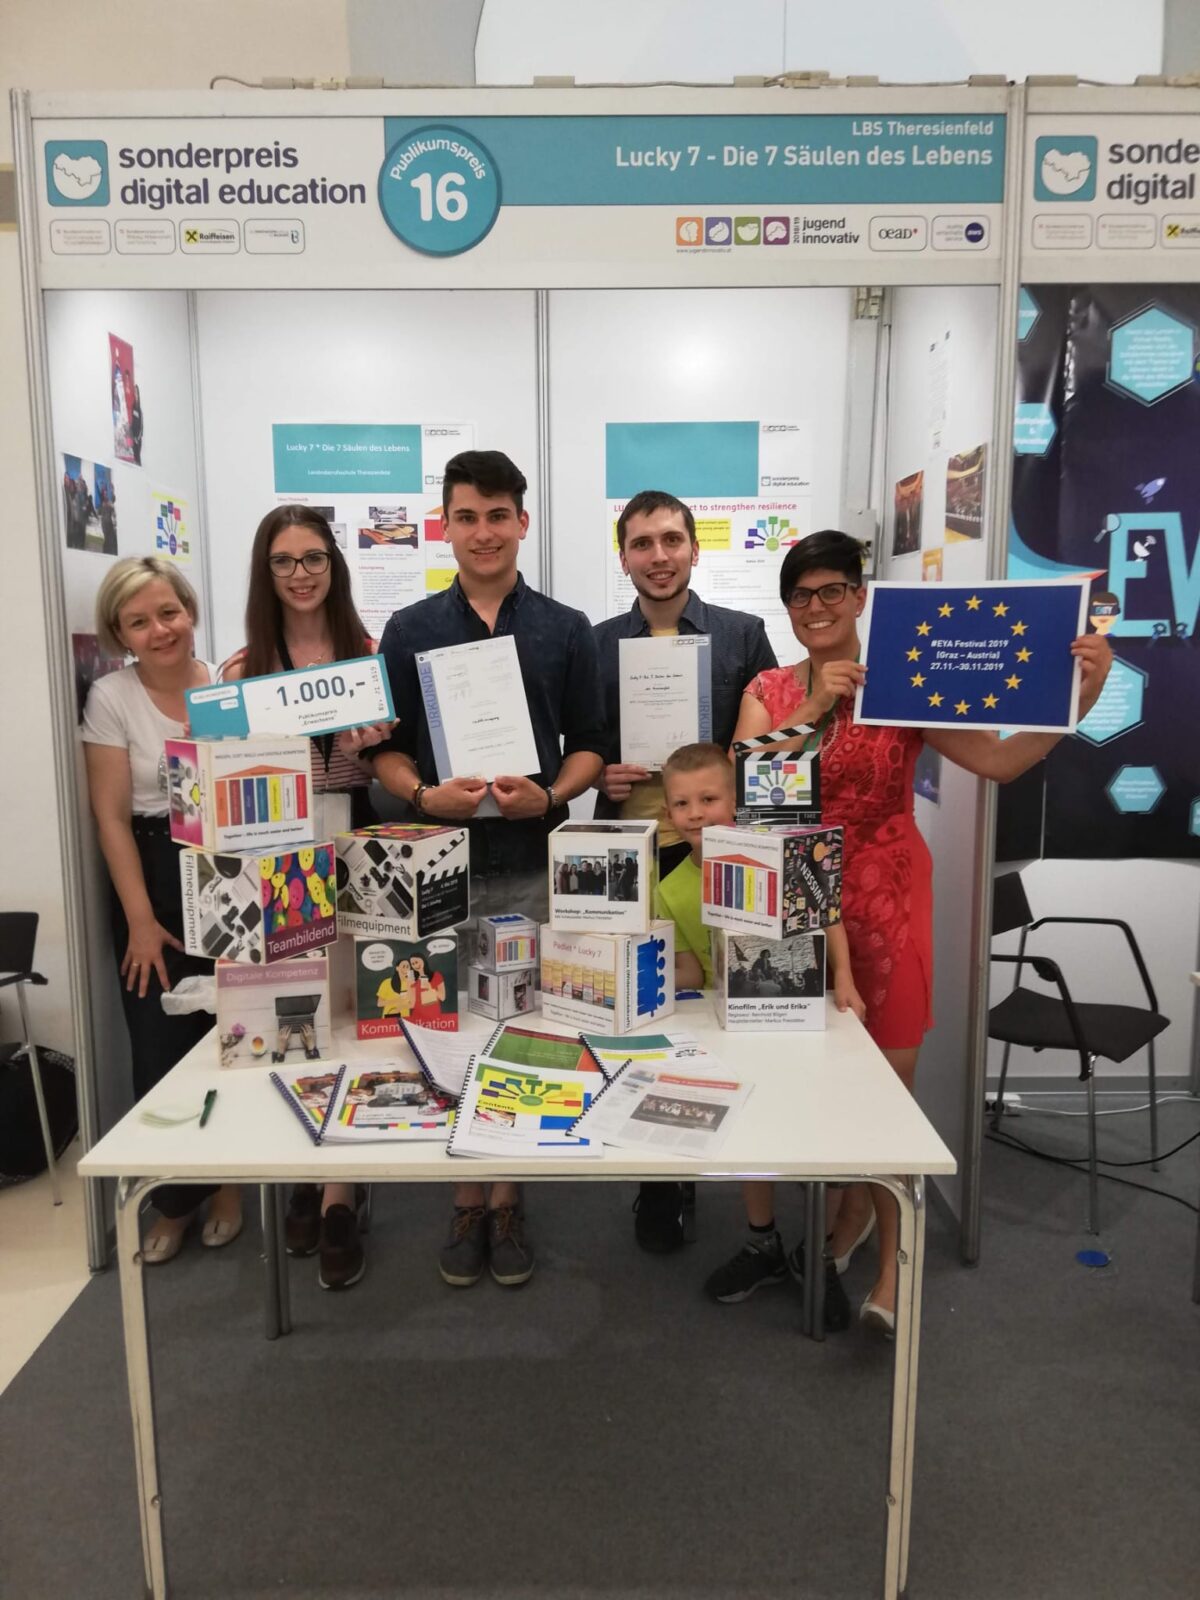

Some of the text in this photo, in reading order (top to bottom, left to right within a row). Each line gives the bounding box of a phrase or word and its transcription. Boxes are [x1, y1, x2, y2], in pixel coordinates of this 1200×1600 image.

[852, 121, 994, 136] LBS Theresienfeld
[118, 141, 299, 174] sonderpreis
[390, 138, 486, 180] Publikumspreis
[616, 146, 681, 171] Lucky
[688, 146, 700, 166] 7
[723, 145, 759, 166] Die
[765, 145, 778, 166] 7
[784, 144, 860, 166] Säulen
[866, 144, 906, 165] des
[912, 144, 993, 166] Lebens
[120, 177, 366, 210] digital education
[410, 172, 469, 221] 16
[1106, 173, 1196, 205] digital
[802, 217, 846, 232] jugend
[200, 232, 235, 240] Raiffeisen
[802, 232, 860, 244] innovativ
[286, 444, 308, 453] Lucky
[322, 444, 335, 452] Die
[370, 444, 382, 452] des
[384, 445, 410, 453] Lebens
[710, 504, 755, 512] strengthen
[931, 640, 1008, 648] #EYA Festival 2019
[420, 667, 442, 729] URKUNDE
[800, 862, 824, 904] WISSEN
[184, 854, 198, 950] Filmequipment
[268, 922, 335, 955] Teambildend
[553, 941, 572, 952] Padlet
[578, 946, 596, 958] Lucky
[226, 967, 318, 985] Digitale Kompetenz
[361, 1018, 455, 1035] Kommikation
